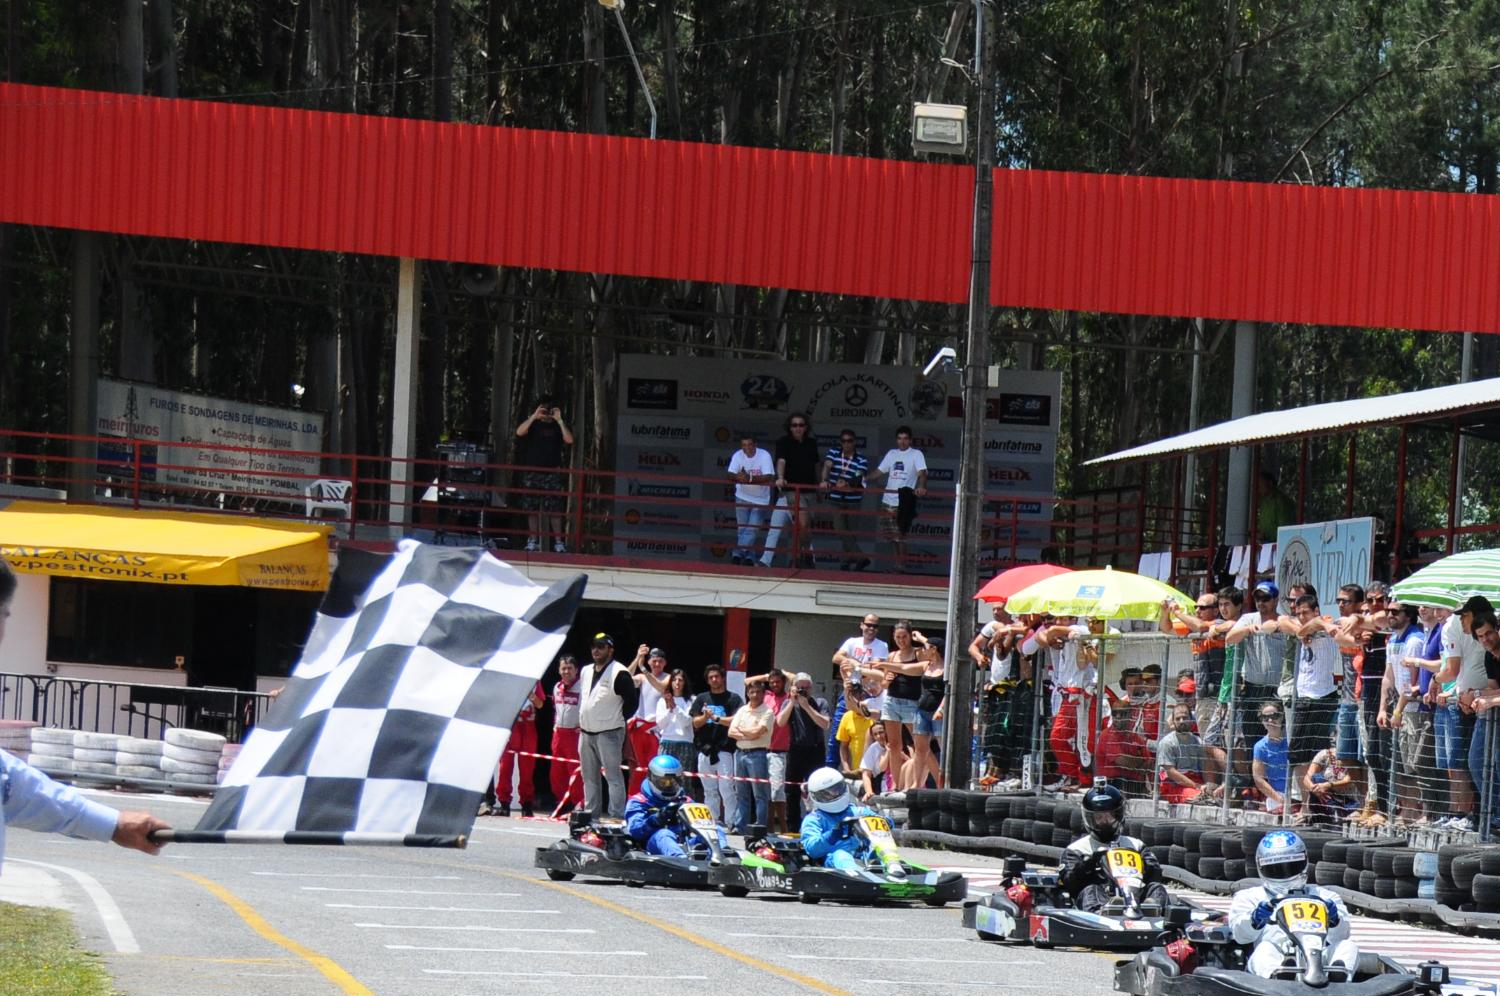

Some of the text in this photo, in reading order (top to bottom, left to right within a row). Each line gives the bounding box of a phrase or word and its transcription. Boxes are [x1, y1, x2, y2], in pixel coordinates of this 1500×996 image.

[748, 377, 776, 396] 24
[684, 391, 730, 400] HONDA
[806, 375, 848, 416] ESCOLA
[857, 373, 906, 418] KARTING
[150, 398, 179, 413] FUROS
[180, 404, 186, 414] E
[188, 406, 240, 423] SONDAGENS
[242, 415, 254, 424] DE
[830, 408, 884, 417] EUROINDY
[257, 434, 267, 444] de
[911, 437, 944, 448] ELIX
[985, 440, 1042, 452] ubrifatima
[199, 450, 211, 461] Em
[213, 454, 248, 467] Qualquer
[249, 458, 265, 470] Tipo
[266, 462, 276, 472] de
[638, 454, 680, 466] HELIX
[988, 469, 1032, 481] HELIX
[270, 479, 300, 491] POMBAL
[641, 486, 688, 495] MICHELIN
[1113, 853, 1137, 868] 93
[1291, 903, 1321, 920] 52
